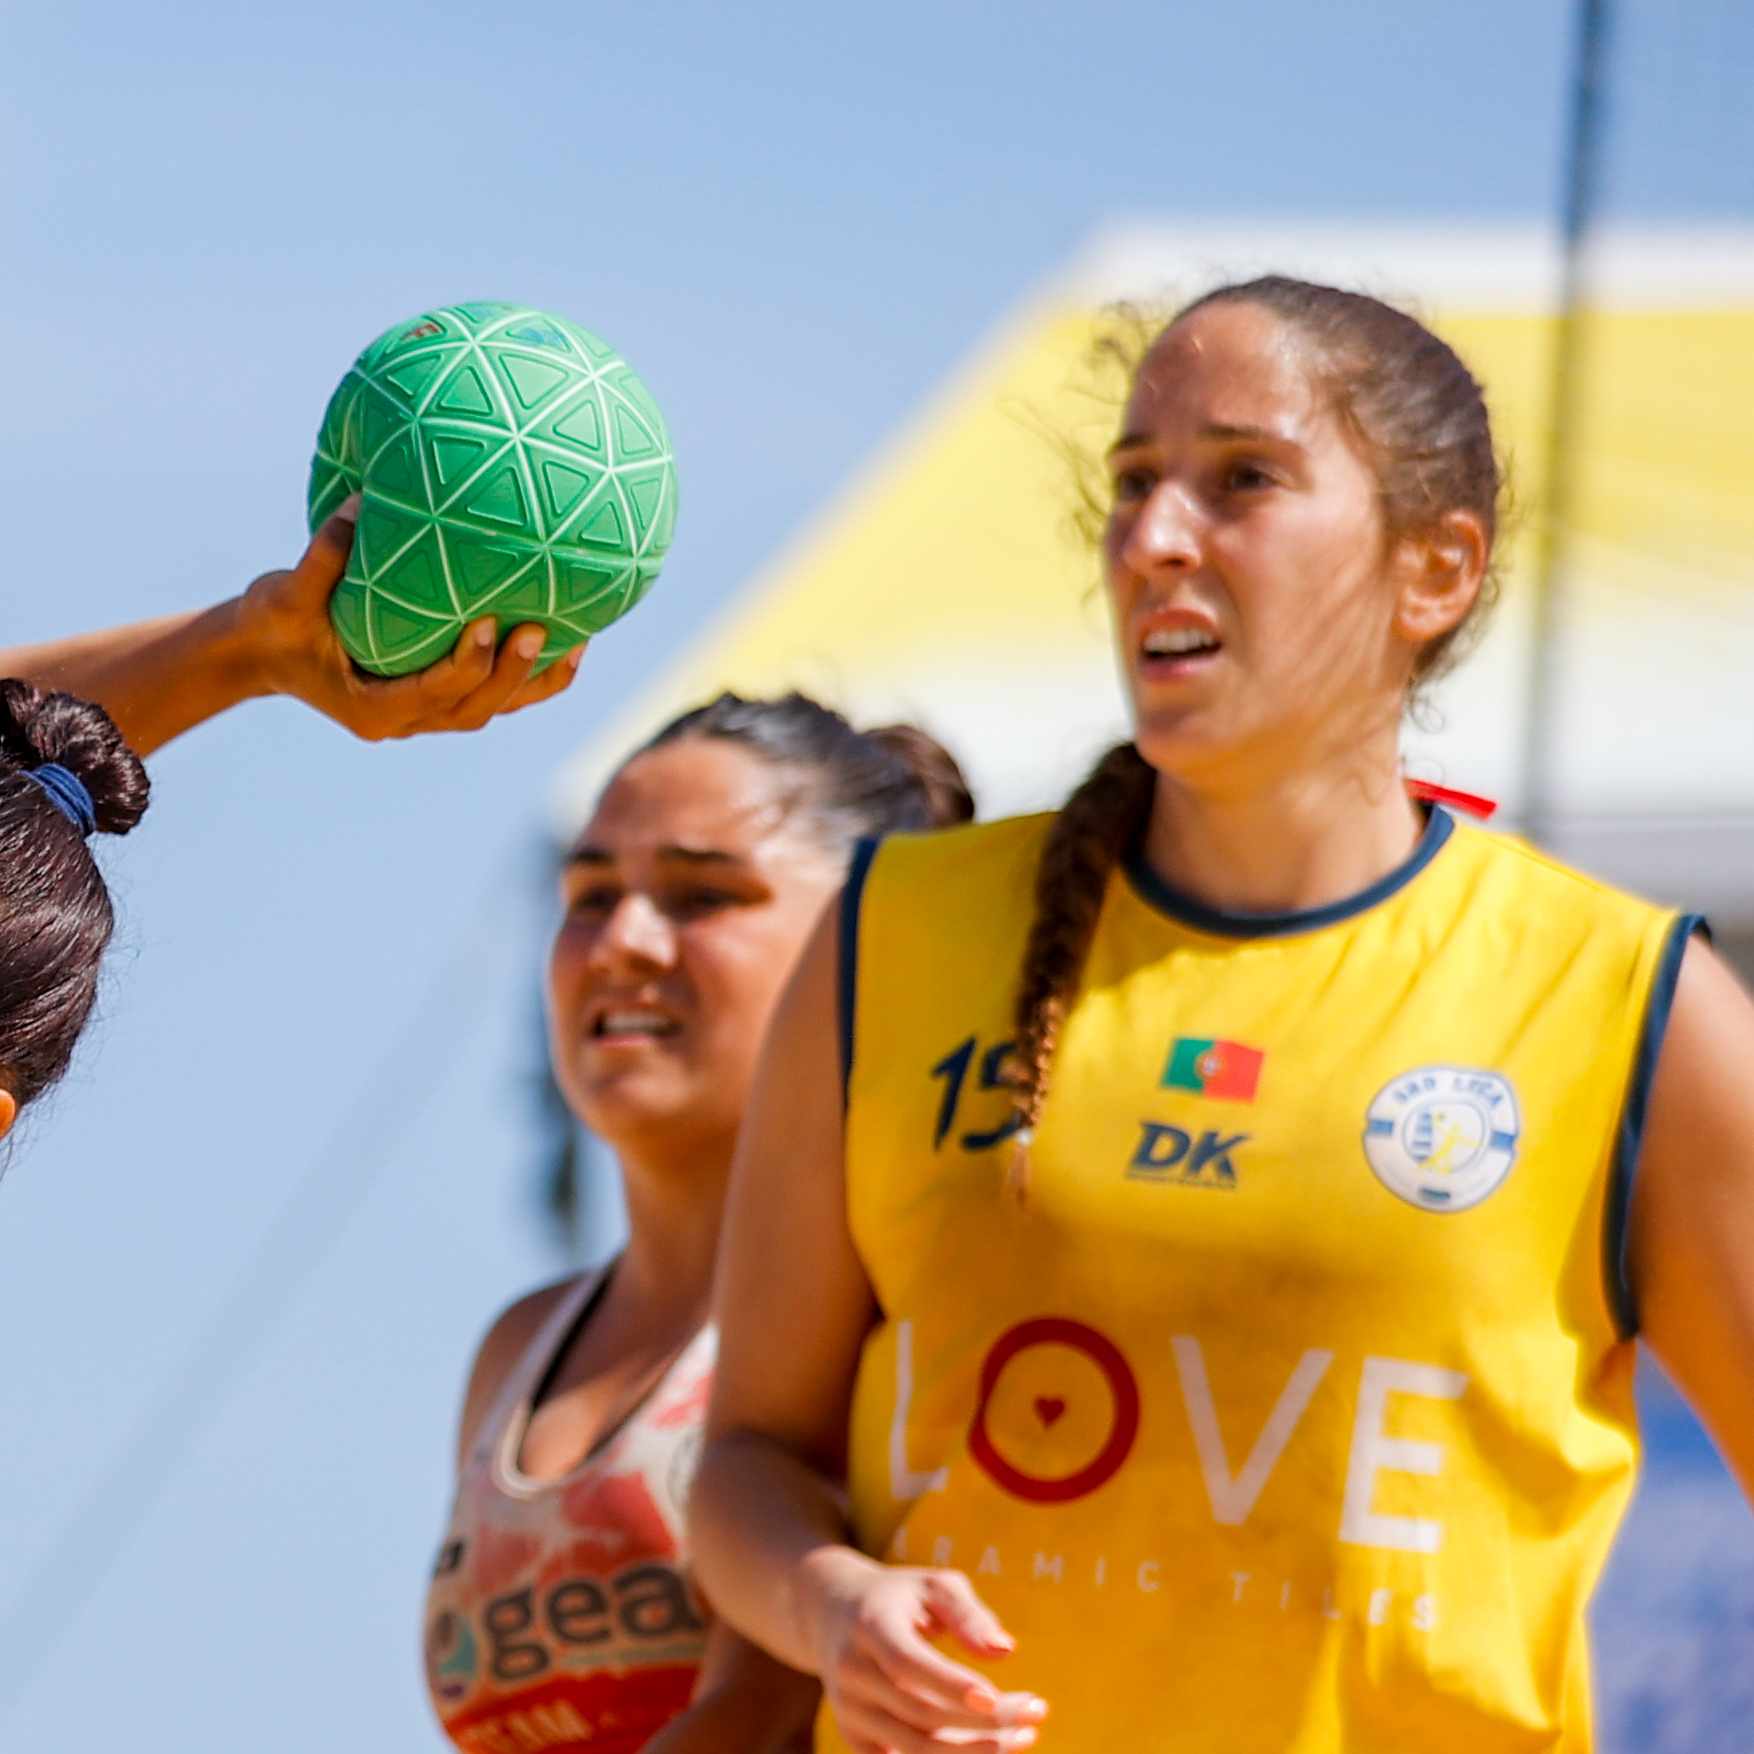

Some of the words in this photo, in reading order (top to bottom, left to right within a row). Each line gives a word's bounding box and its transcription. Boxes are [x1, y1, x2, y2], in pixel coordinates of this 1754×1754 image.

[1138, 1120, 1250, 1179] DK
[890, 1316, 1469, 1555] LOVE
[484, 1564, 702, 1681] gea
[1229, 1570, 1435, 1631] TILES
